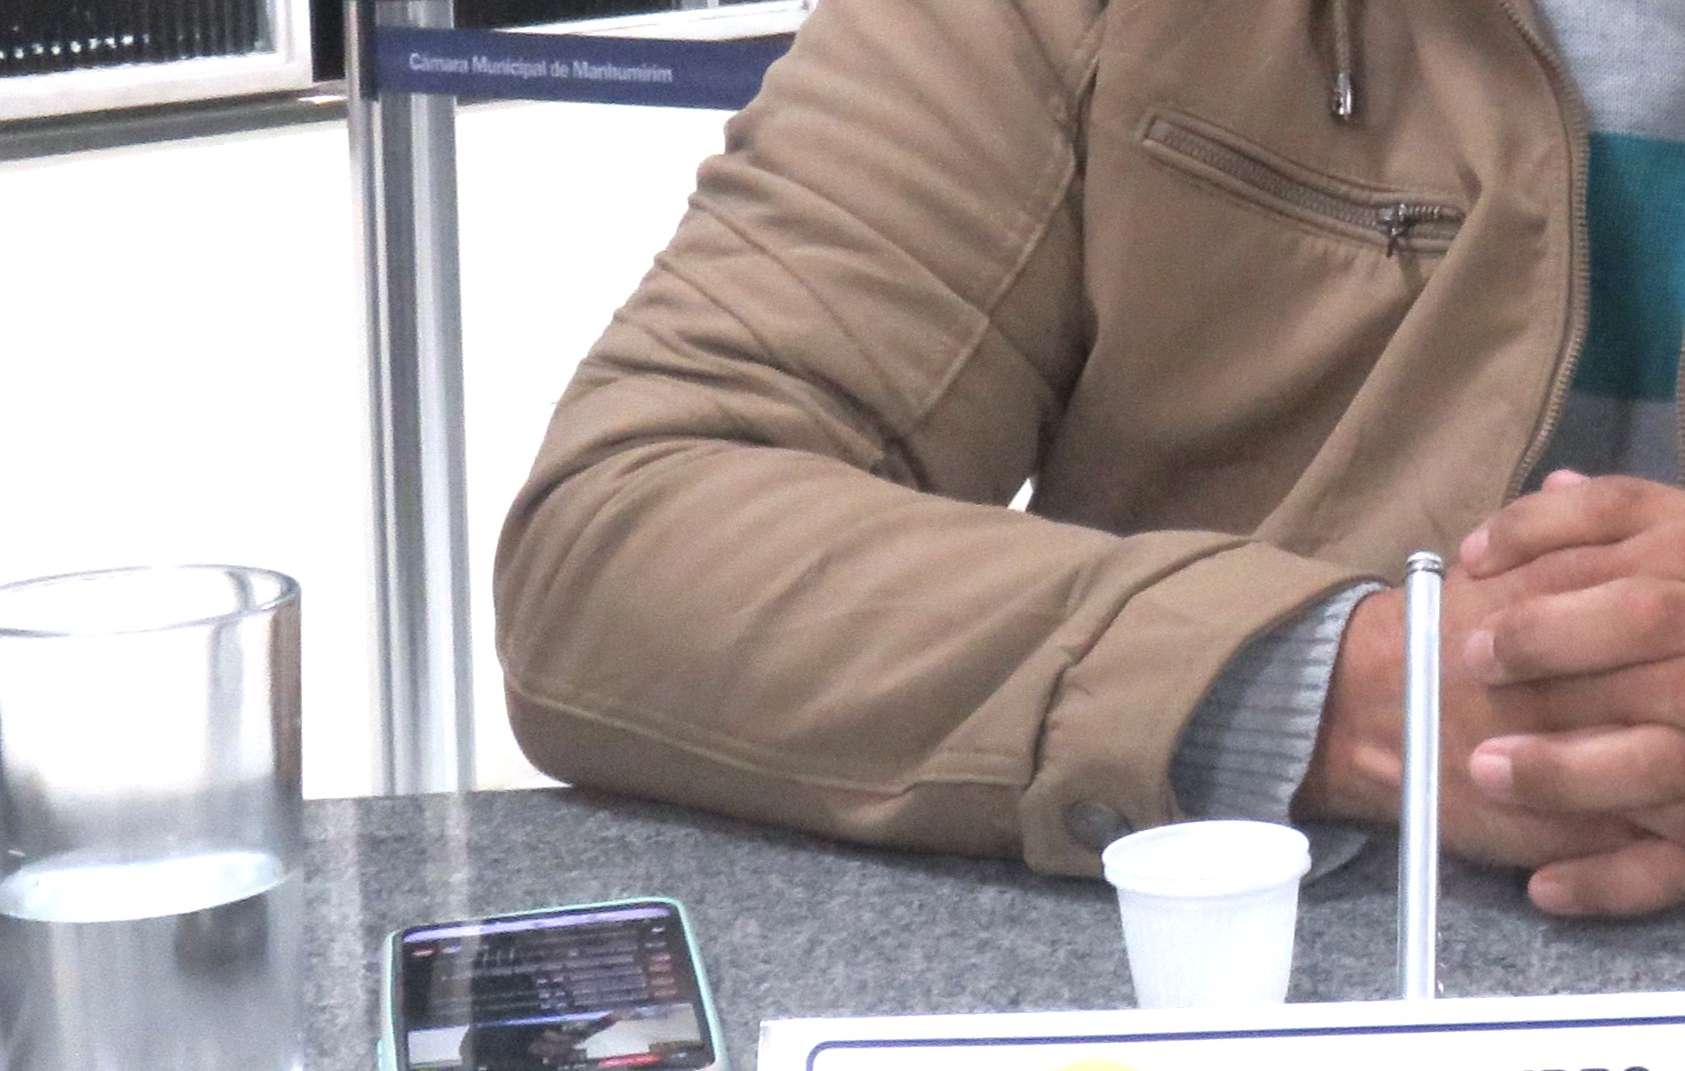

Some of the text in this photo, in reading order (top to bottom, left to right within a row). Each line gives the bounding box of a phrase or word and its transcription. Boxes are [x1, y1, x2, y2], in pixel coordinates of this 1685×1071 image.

[472, 55, 547, 80] Municipal
[551, 61, 569, 79] de
[573, 60, 673, 83] Manhumirim
